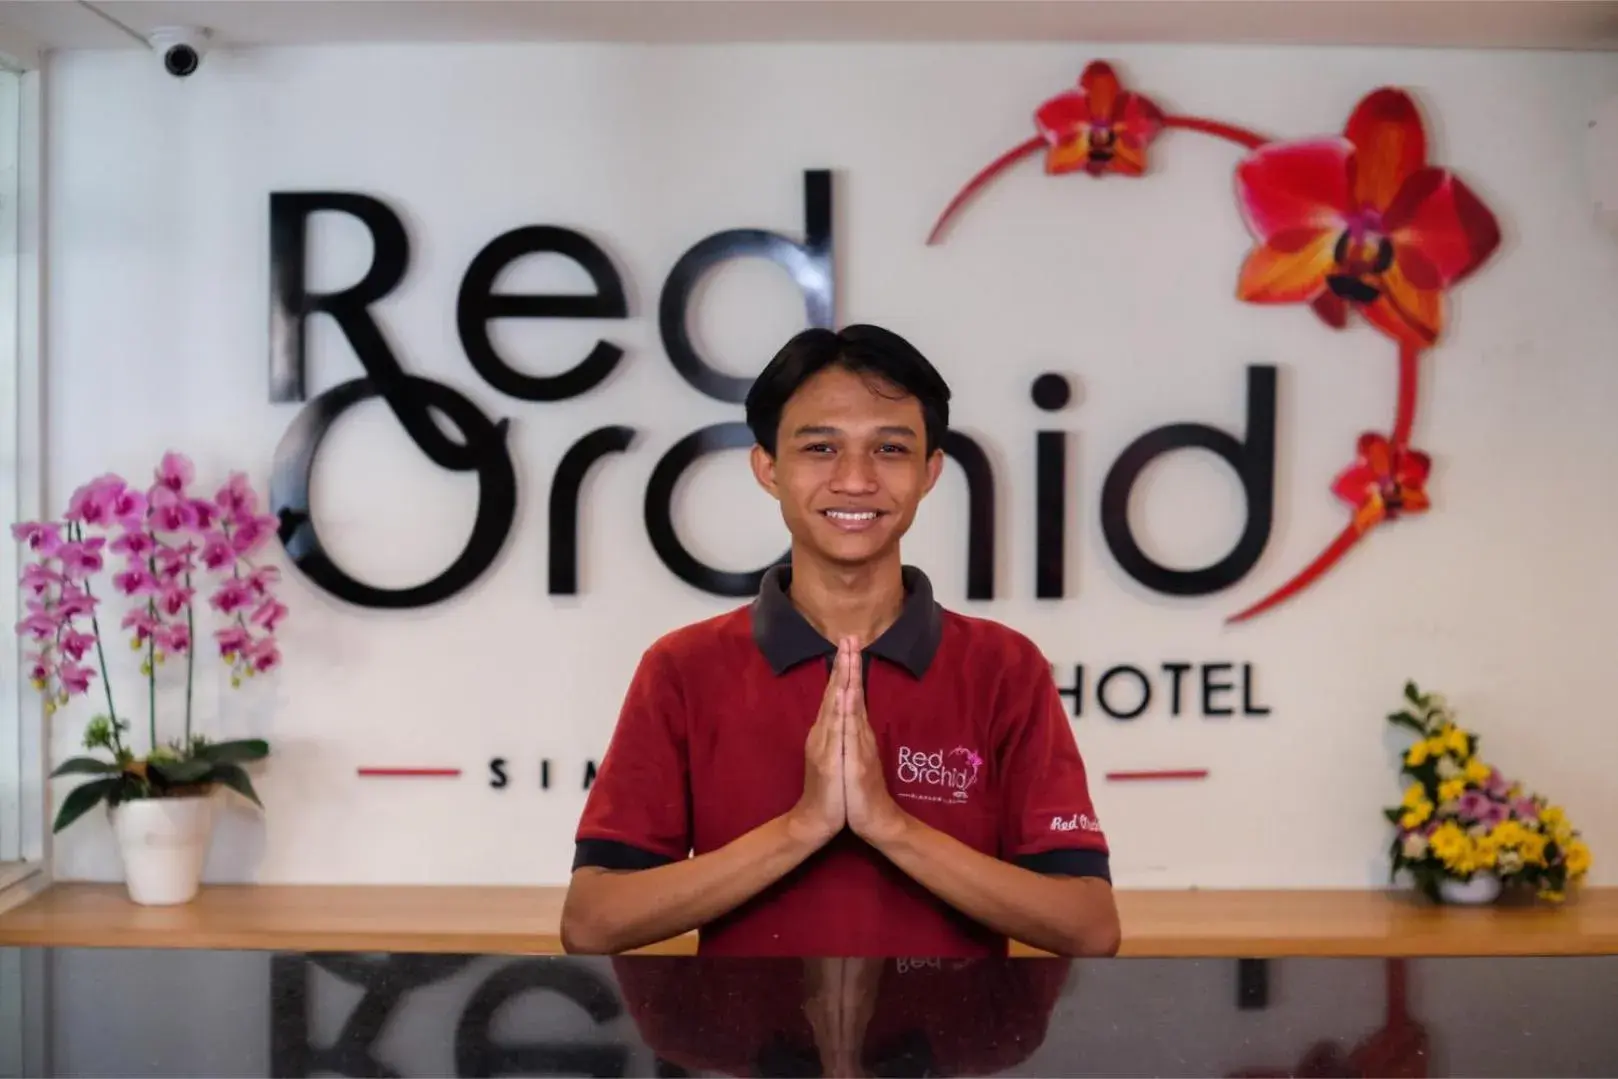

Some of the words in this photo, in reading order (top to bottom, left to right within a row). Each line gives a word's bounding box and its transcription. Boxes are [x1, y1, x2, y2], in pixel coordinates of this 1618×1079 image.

[269, 169, 834, 405] Red
[898, 746, 943, 769] Red
[898, 762, 967, 789] Orchid
[1050, 813, 1079, 831] Red
